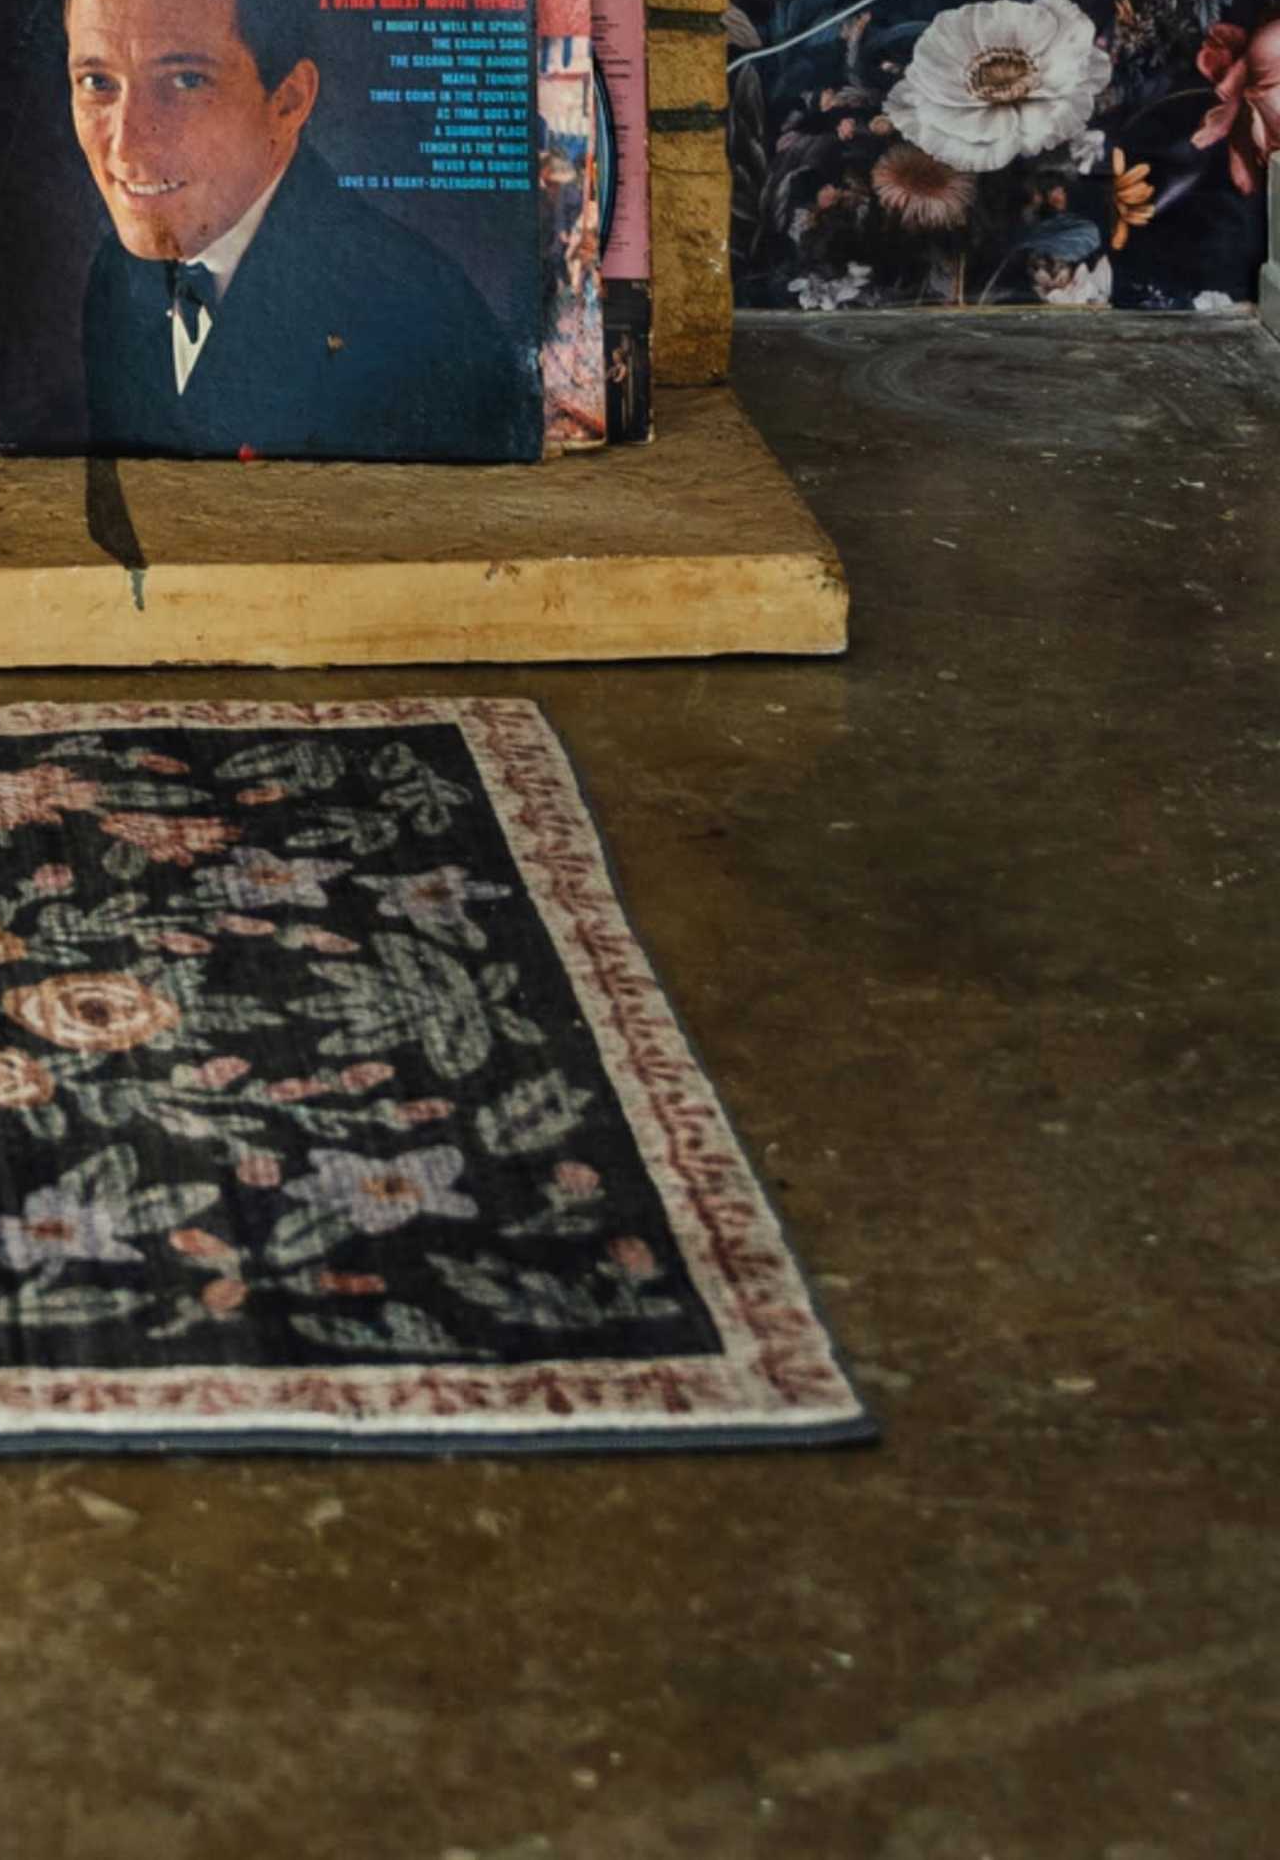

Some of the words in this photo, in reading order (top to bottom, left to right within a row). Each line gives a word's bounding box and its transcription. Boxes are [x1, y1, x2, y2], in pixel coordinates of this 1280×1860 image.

[441, 20, 468, 31] WELL
[390, 55, 408, 67] THE
[412, 55, 453, 67] SECOND
[457, 55, 481, 67] TIME
[370, 89, 401, 102] THREE
[405, 89, 436, 102] COINS
[454, 89, 473, 102] THE
[477, 89, 528, 102] FOUNTAIN
[454, 108, 479, 120] TIME
[496, 125, 528, 137] PLACE
[420, 142, 457, 154] TENDER
[476, 142, 493, 154] THE
[433, 160, 465, 172] NEVER
[339, 176, 364, 188] LOVE
[500, 178, 529, 190] THING
